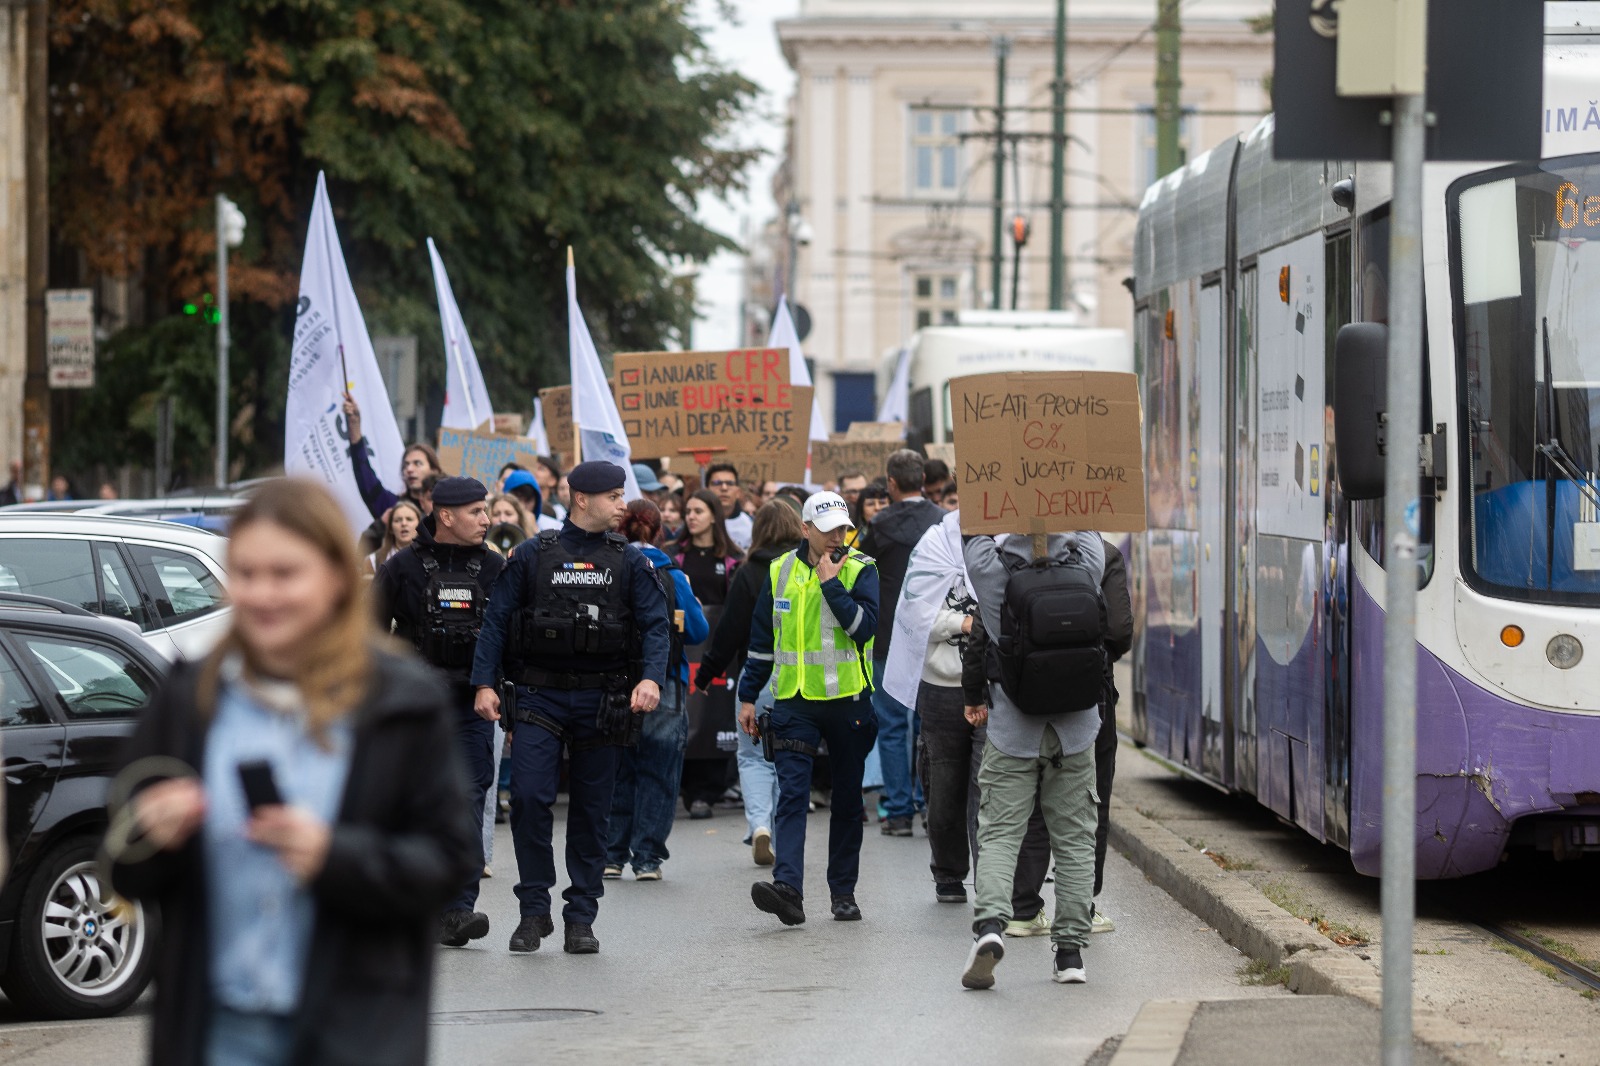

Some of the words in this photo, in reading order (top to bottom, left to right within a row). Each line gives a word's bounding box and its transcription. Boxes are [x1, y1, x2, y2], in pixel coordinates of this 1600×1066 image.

[725, 349, 781, 382] CFR
[682, 383, 792, 411] BURSELE
[1035, 392, 1110, 418] PROMIS
[645, 411, 680, 438] MAI
[687, 408, 768, 436] DEPARTE
[772, 409, 794, 433] CE
[1023, 420, 1067, 452] 6%,
[756, 434, 790, 452] ???
[964, 461, 1002, 485] DAR
[1085, 463, 1128, 483] DOAR
[983, 490, 1019, 521] LA
[1035, 486, 1115, 518] DERUTĂ
[551, 571, 605, 586] JANDARMERIA
